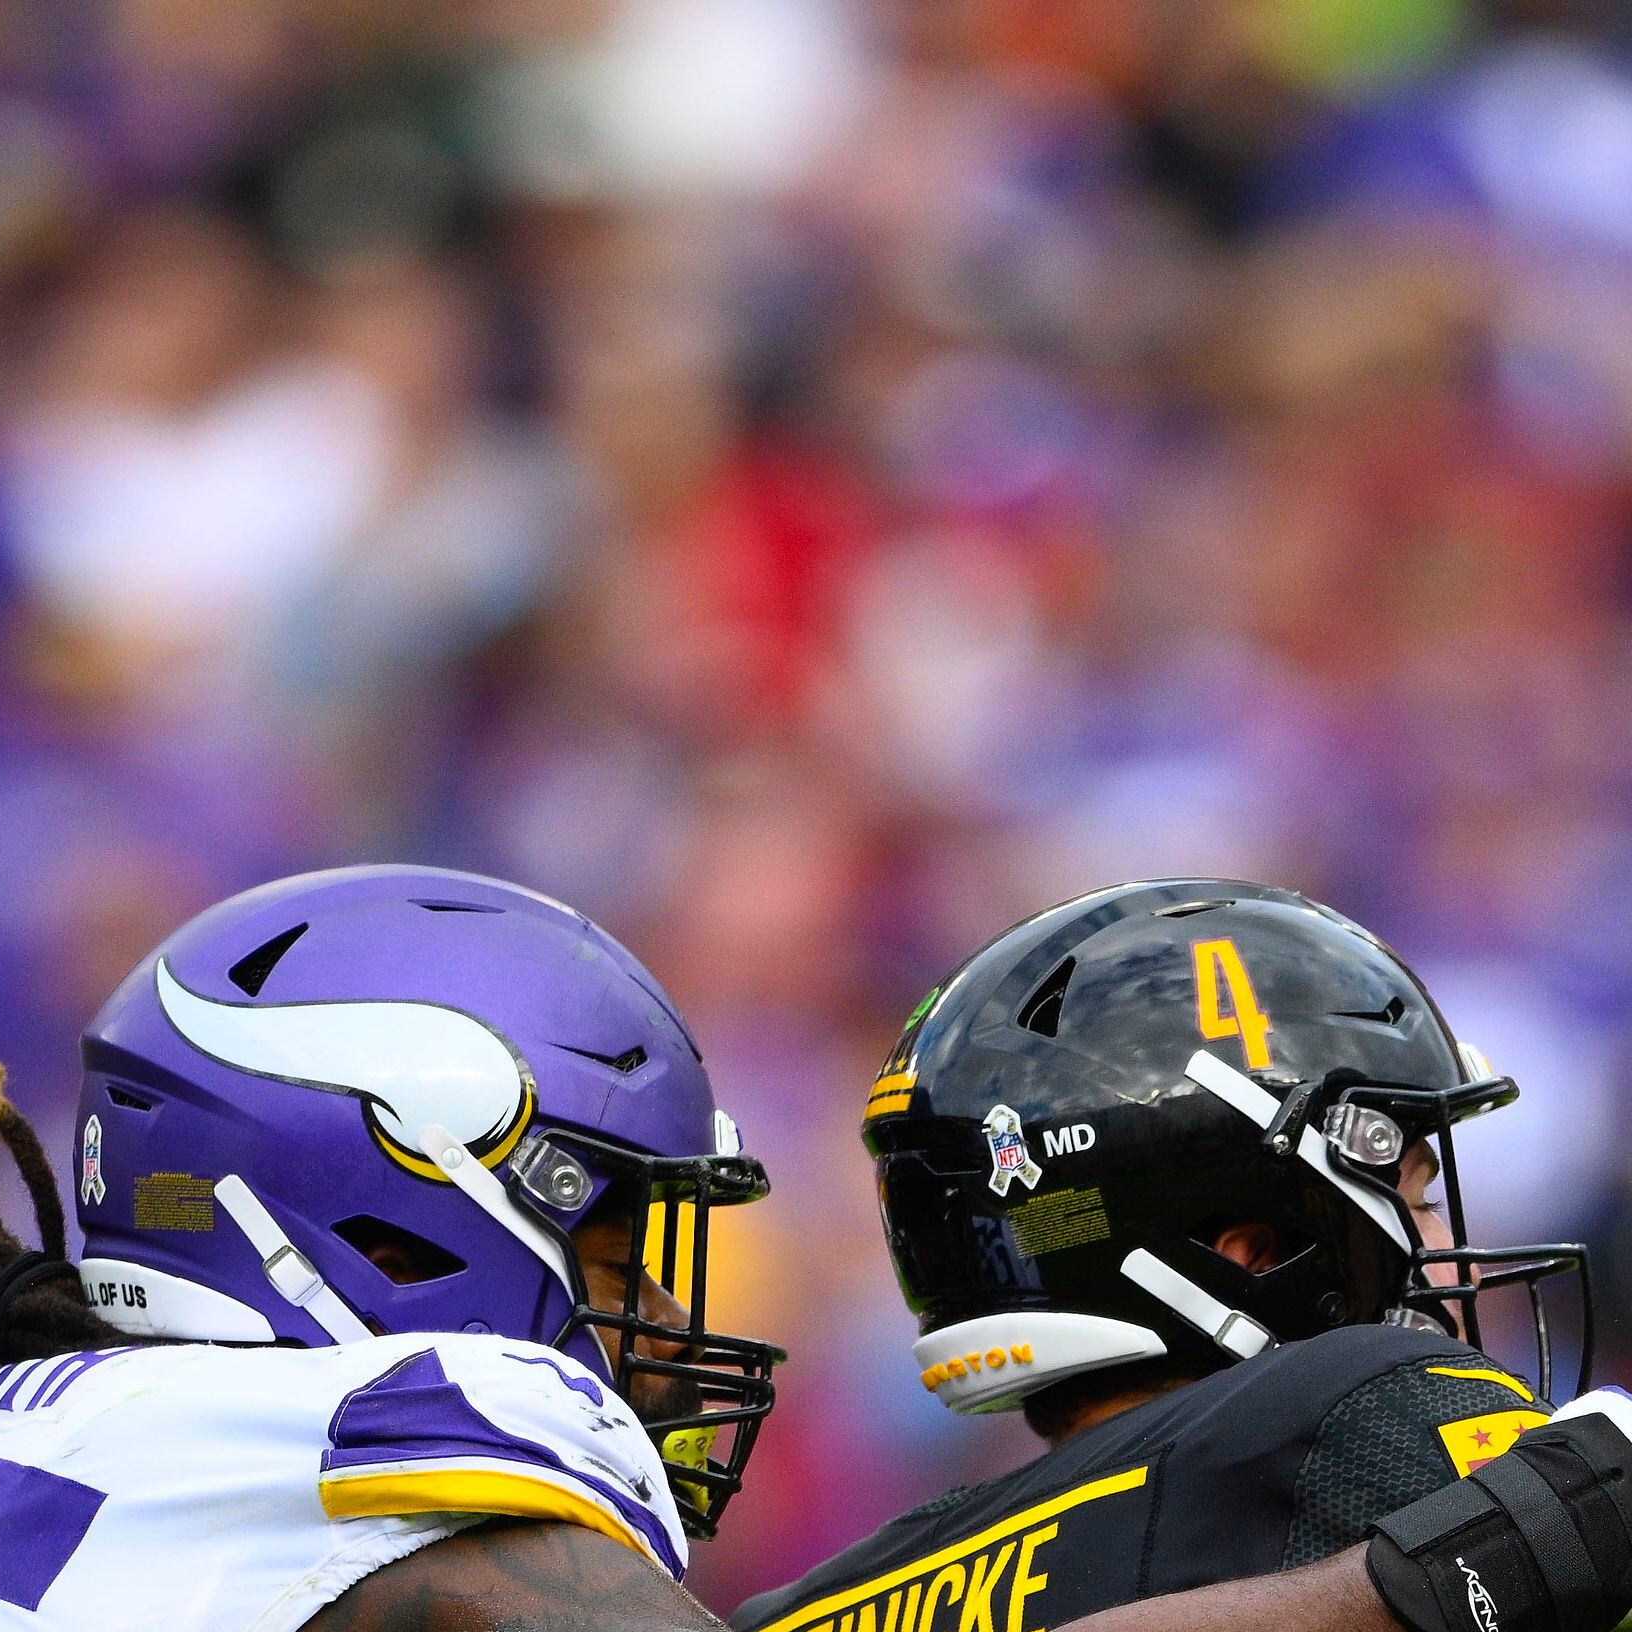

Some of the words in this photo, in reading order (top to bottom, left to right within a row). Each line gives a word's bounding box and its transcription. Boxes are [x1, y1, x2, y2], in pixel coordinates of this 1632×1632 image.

[1189, 936, 1274, 1072] 4
[1042, 1123, 1096, 1158] MD
[998, 1147, 1023, 1167] NFL
[99, 1282, 117, 1306] OF
[122, 1283, 148, 1309] US
